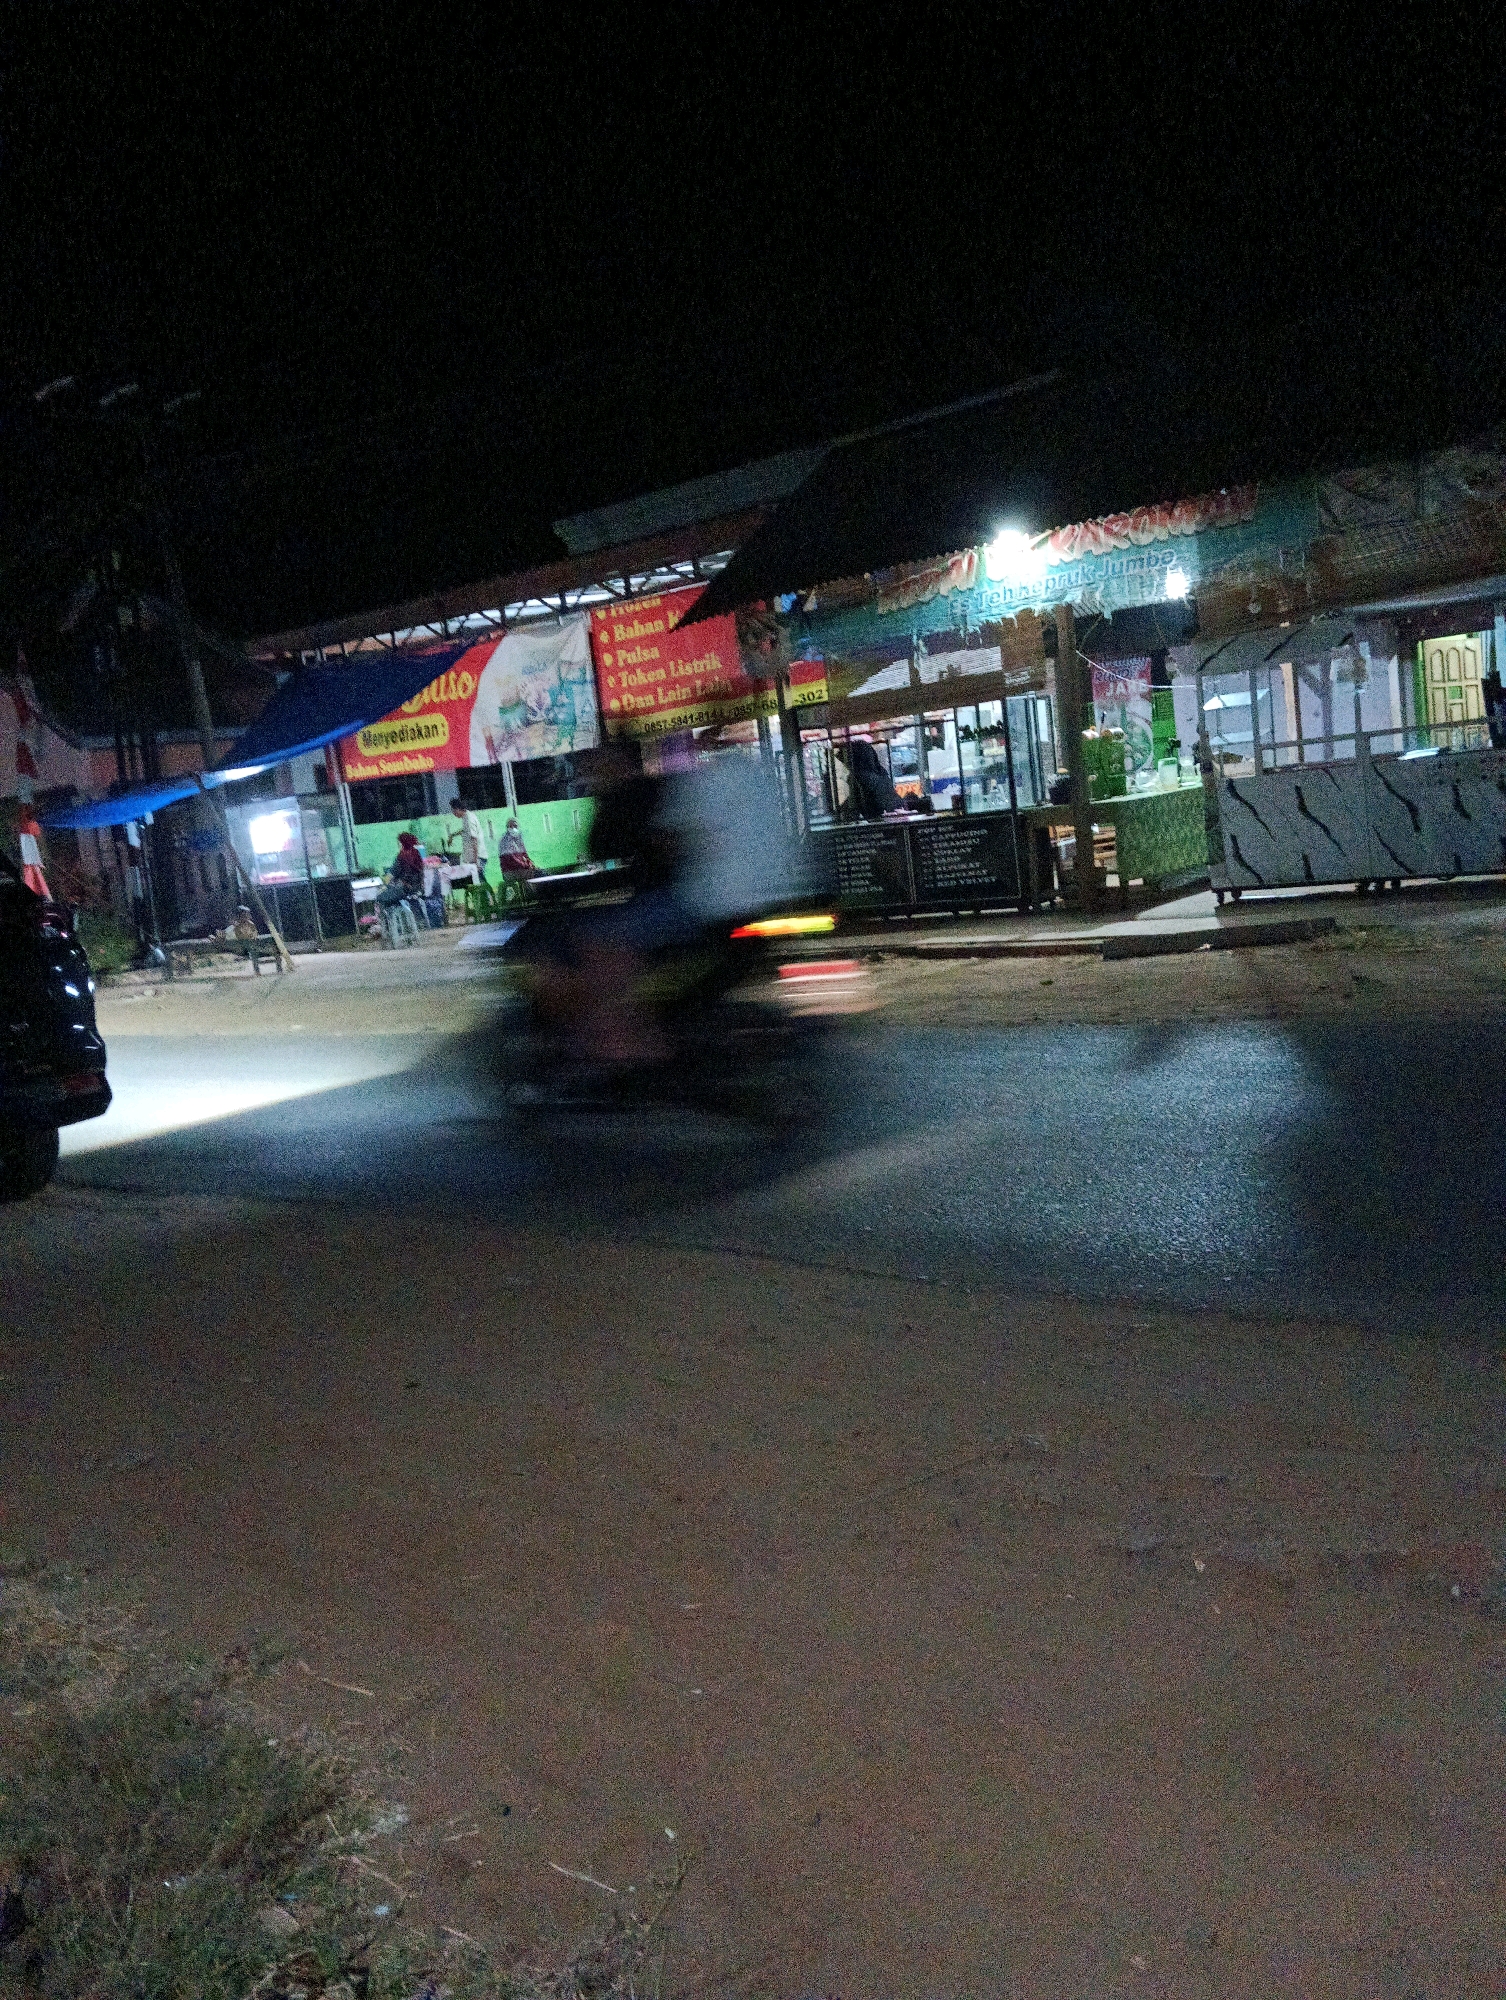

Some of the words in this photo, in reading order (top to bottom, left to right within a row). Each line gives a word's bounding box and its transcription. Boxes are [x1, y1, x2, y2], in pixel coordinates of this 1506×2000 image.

[1097, 548, 1178, 579] Jumbo
[613, 619, 665, 642] Bahan
[617, 646, 660, 668] Pulsa
[618, 668, 667, 688] Token
[669, 652, 722, 678] Listrik
[621, 692, 655, 712] Dan
[657, 684, 692, 706] Lain
